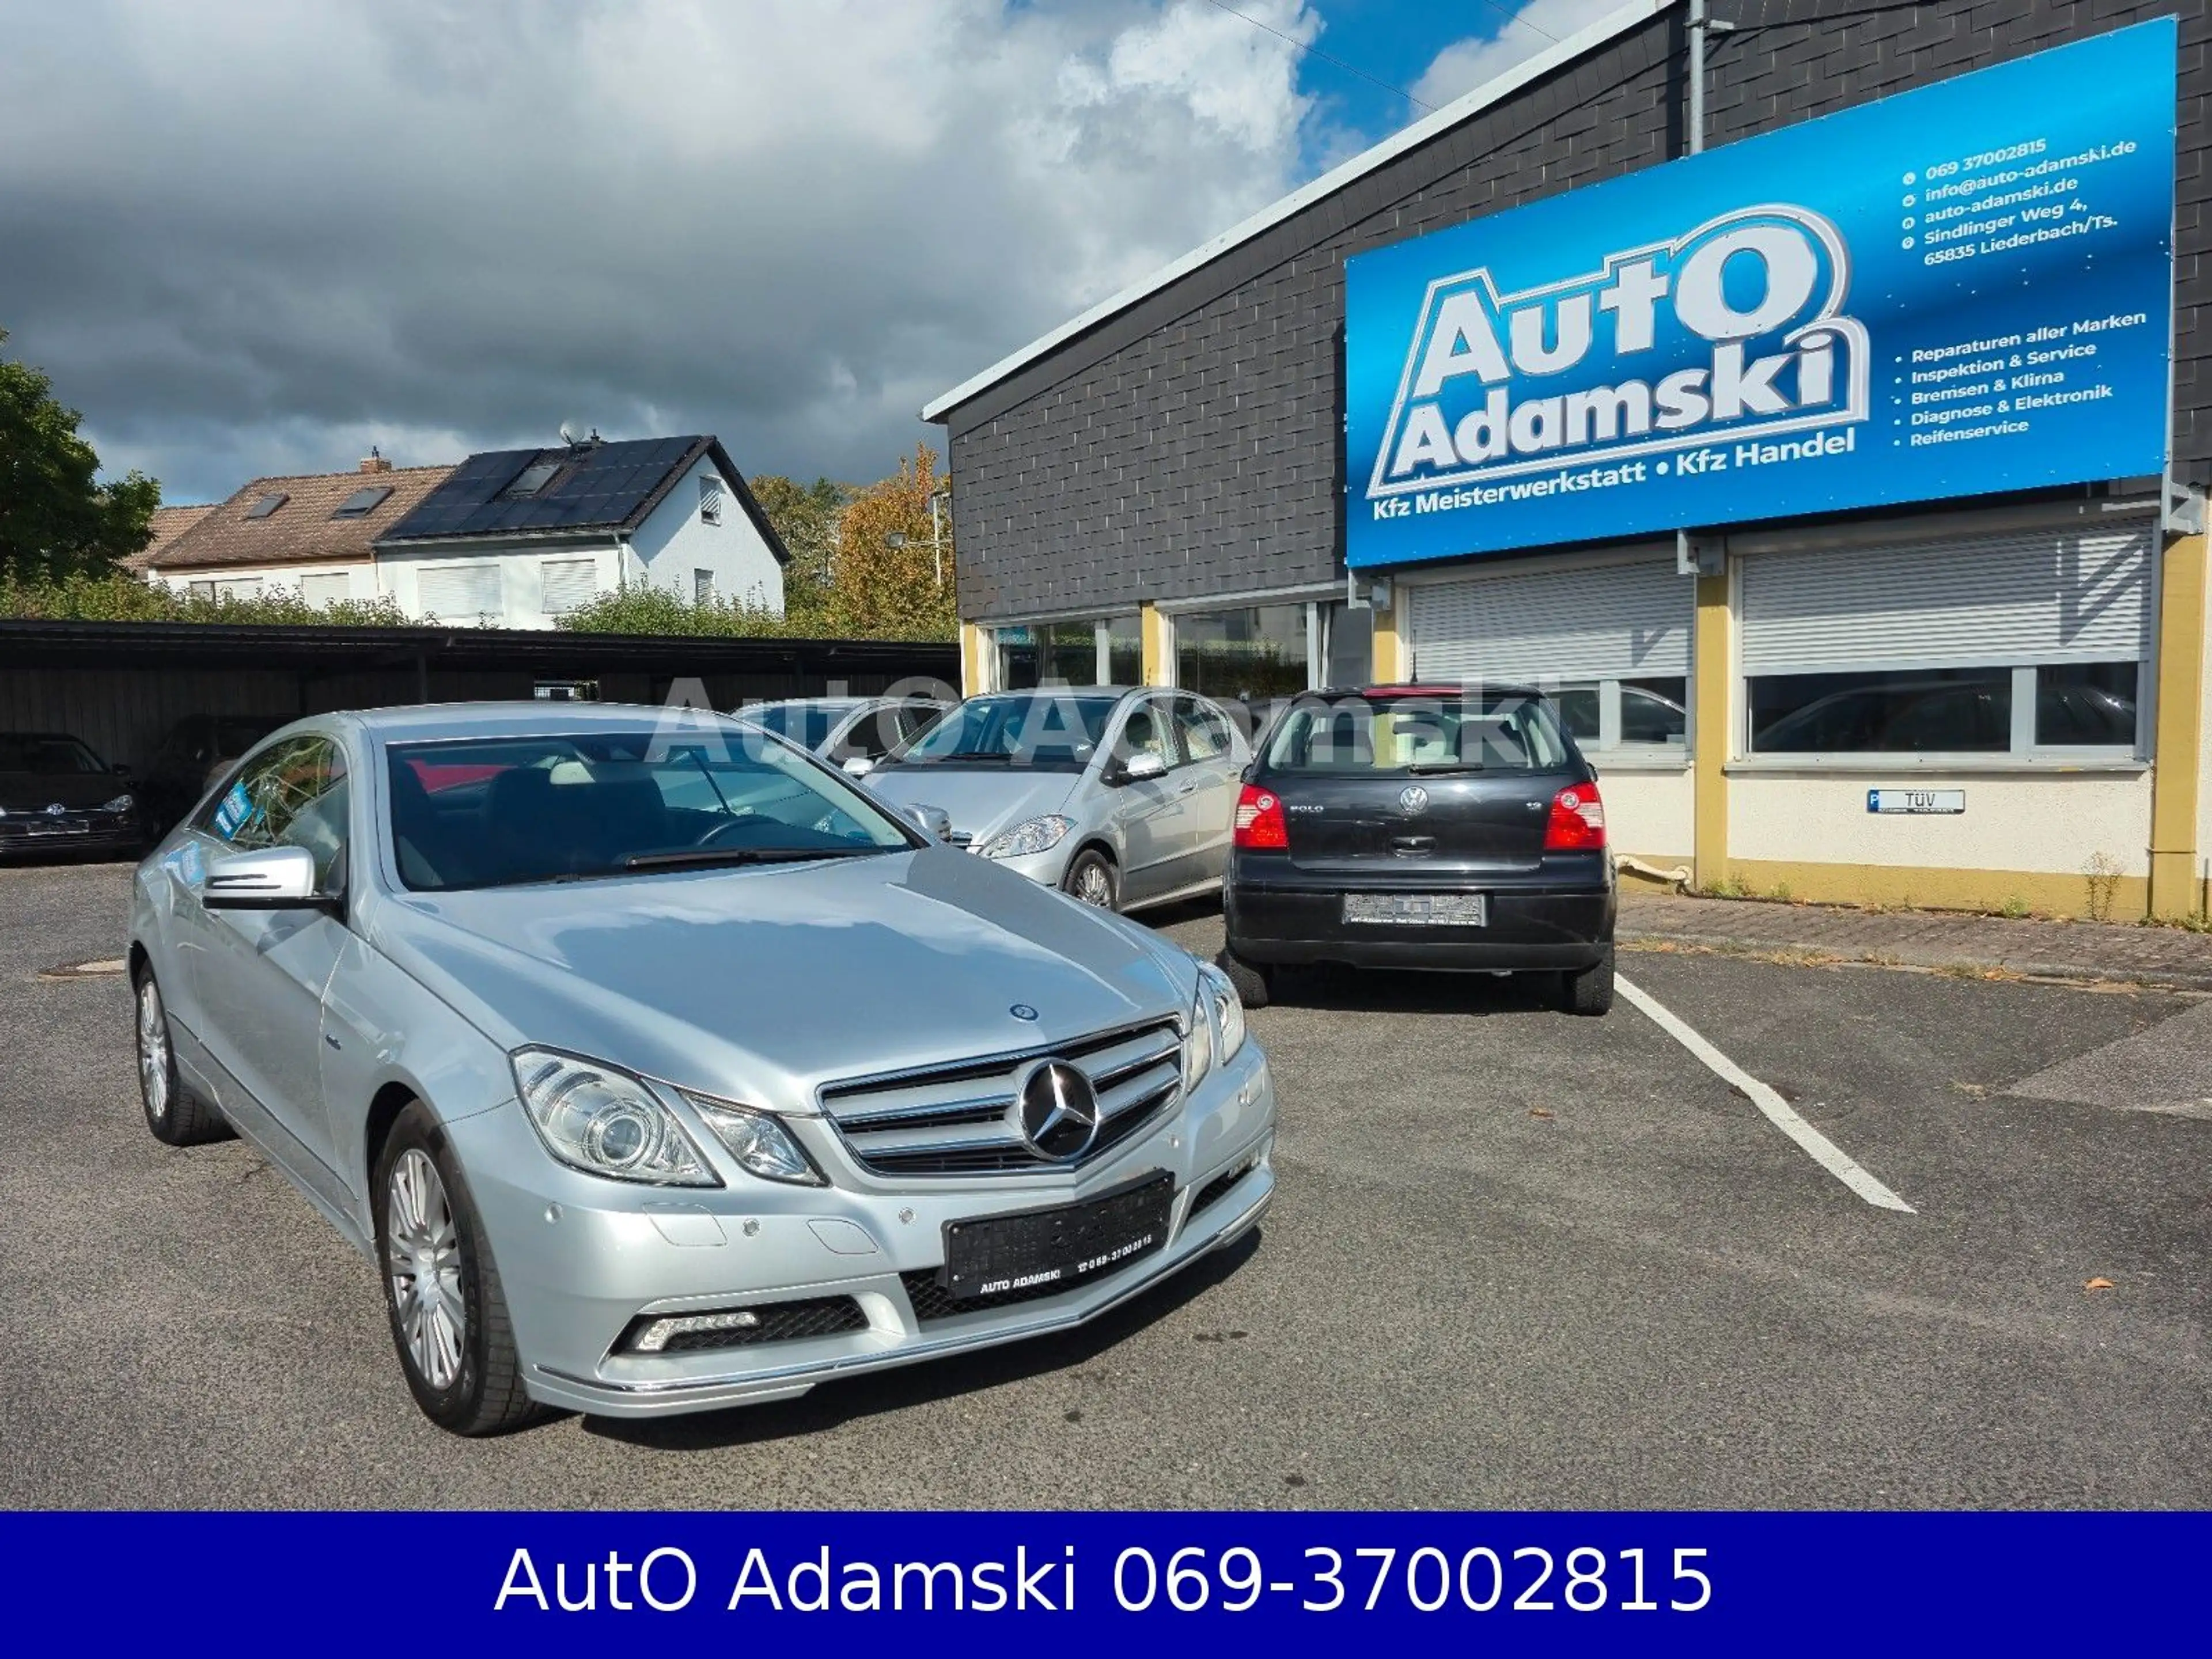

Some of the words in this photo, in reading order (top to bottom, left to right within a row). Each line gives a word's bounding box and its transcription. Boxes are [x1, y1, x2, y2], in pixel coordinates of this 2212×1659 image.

[1926, 161, 1958, 180] 069
[1962, 138, 2046, 170] 37002815
[1926, 141, 2137, 201] info@auto-adamski.de
[1924, 214, 2016, 244] Sindlinger
[2021, 204, 2064, 223] Weg
[2069, 198, 2088, 212] 4,
[1925, 177, 2078, 223] auto-adamski.de
[1924, 244, 1975, 266] 65835
[1980, 215, 2118, 254] Liederbach/Ts.
[1912, 334, 2021, 362] Reparaturen
[2026, 326, 2067, 343] aller
[2073, 312, 2146, 335] Marken
[1912, 357, 2003, 384] Inspektion
[2009, 354, 2021, 367] &
[2027, 343, 2097, 365] Service
[1390, 332, 1834, 476] Adamski
[1911, 403, 1992, 426] Diagnose
[1997, 400, 2009, 413] &
[2015, 384, 2112, 410] Elektronik
[1912, 381, 1988, 405] Bremsen
[1993, 379, 2006, 392] &
[2012, 370, 2064, 389] Klima
[1911, 421, 2030, 446] Reifenservice
[1373, 499, 1411, 521] Kfz
[1415, 462, 1646, 514] Meisterwerkstatt
[1676, 449, 1726, 476] Kfz
[1735, 427, 1855, 467] Handel
[1906, 792, 1936, 806] TÜV
[980, 1279, 1010, 1294] AUTO
[1013, 1269, 1060, 1289] ADAMSKI
